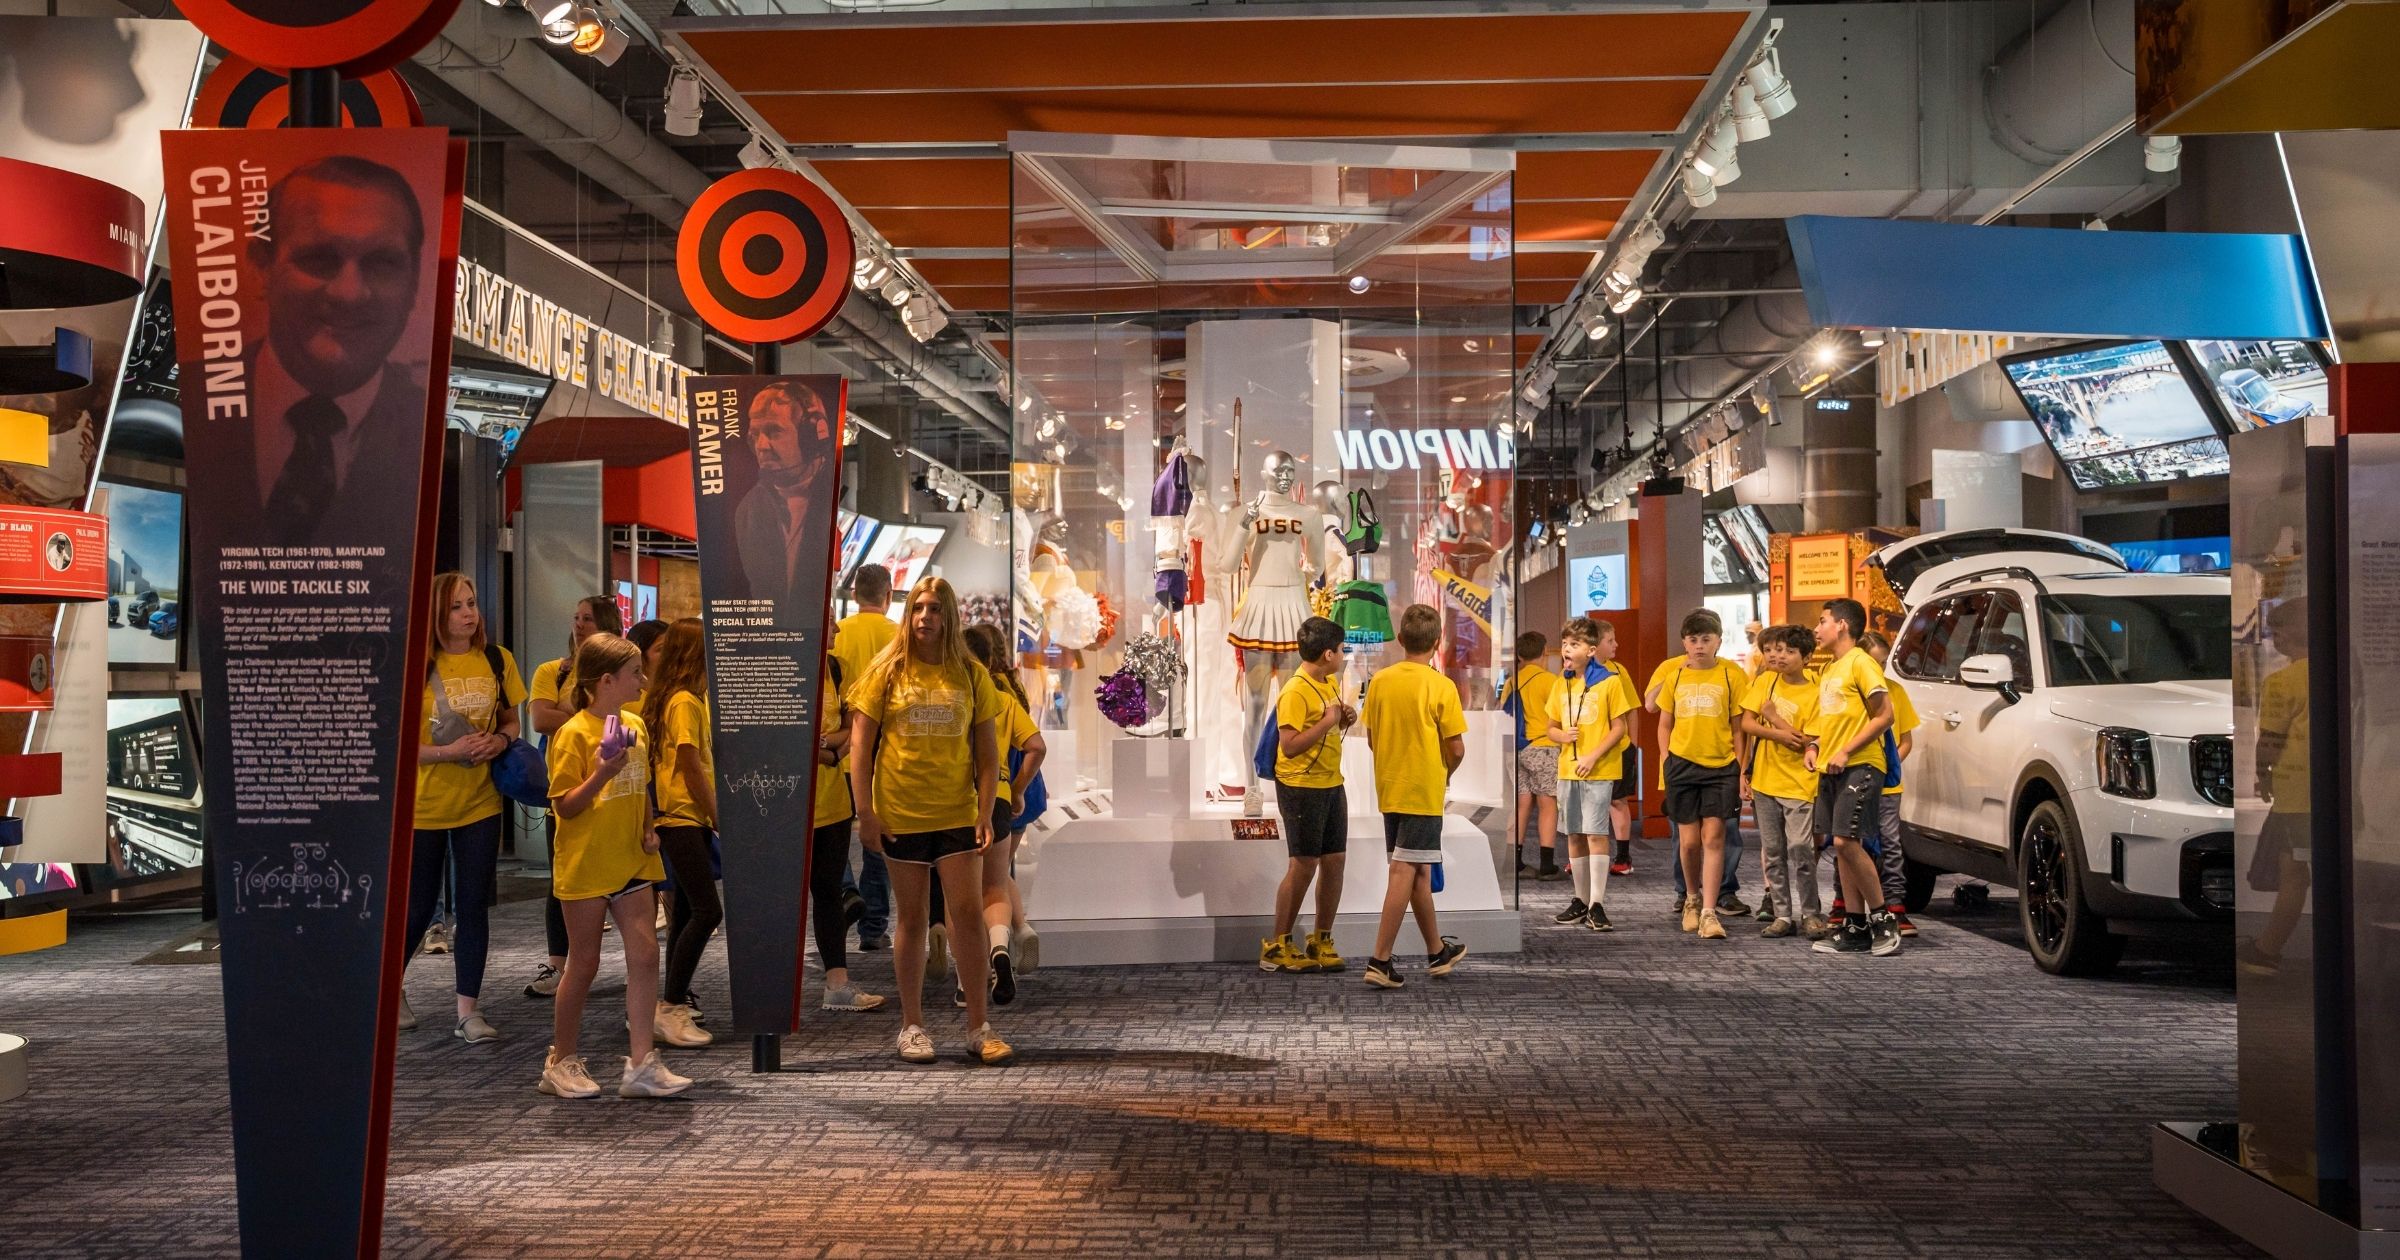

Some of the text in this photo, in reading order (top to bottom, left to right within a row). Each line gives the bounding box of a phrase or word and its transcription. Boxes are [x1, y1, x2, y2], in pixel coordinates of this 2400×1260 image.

[239, 159, 272, 242] JERRY
[109, 223, 138, 250] MIAMI
[189, 166, 248, 421] CLAIBORNE
[595, 327, 700, 430] CHALLE
[722, 388, 741, 440] FRANK
[695, 390, 724, 496] BEAMER
[1255, 518, 1303, 535] USC
[221, 547, 260, 556] VIRGINIA
[262, 547, 284, 556] TECH
[336, 547, 385, 556] MARYLAND
[269, 560, 315, 569] KENTUCKY
[220, 580, 370, 594] THE WIDE TACKLE SIX
[713, 618, 773, 626] SPECIAL TEAMS
